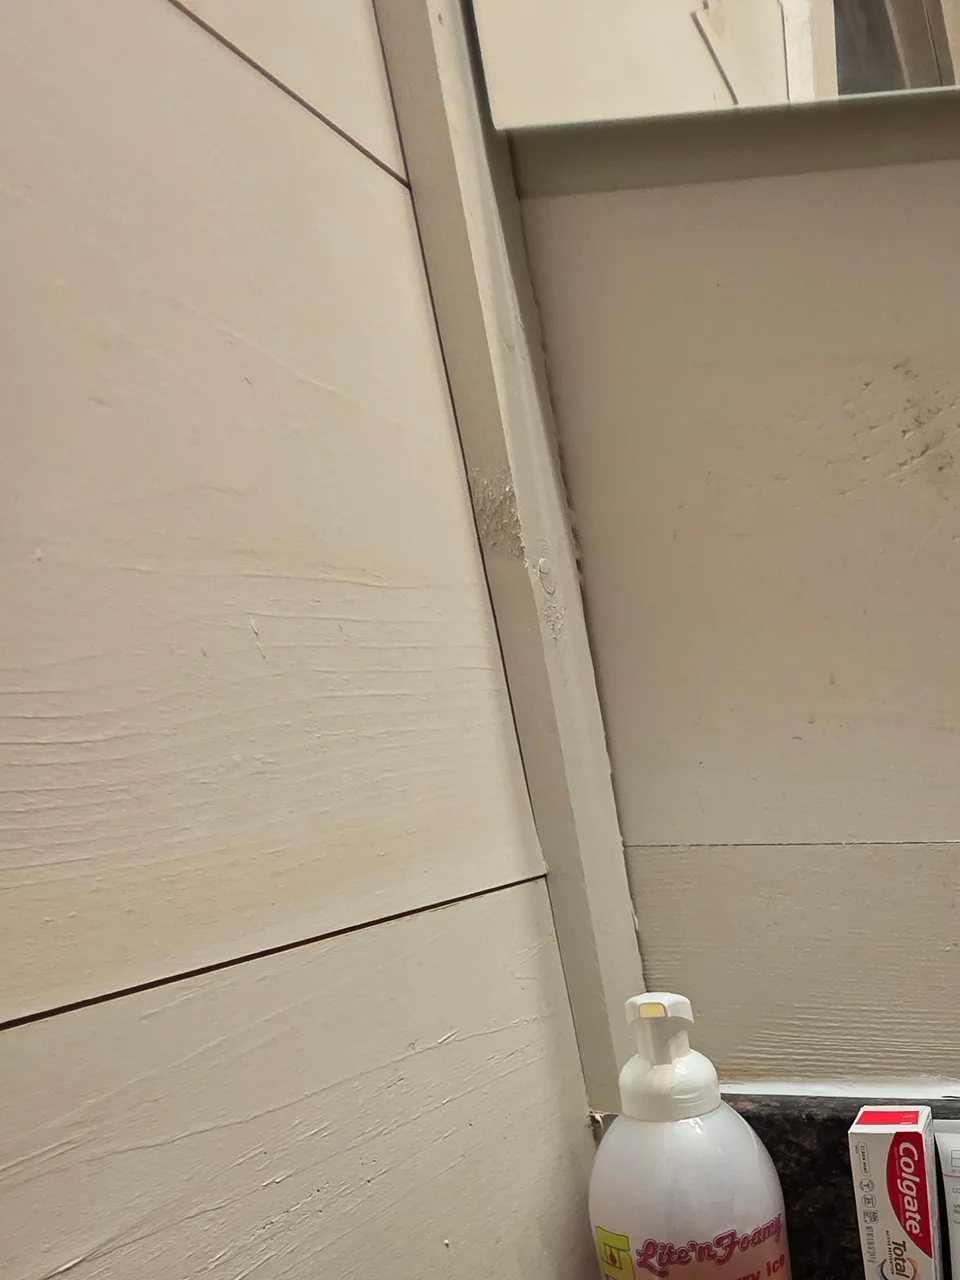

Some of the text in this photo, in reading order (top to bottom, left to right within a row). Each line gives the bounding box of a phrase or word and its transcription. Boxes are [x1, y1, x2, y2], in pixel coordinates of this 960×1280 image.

[897, 1142, 923, 1234] Colgate
[712, 1212, 782, 1266] Foamy
[892, 1240, 910, 1279] Total
[766, 1254, 786, 1279] Ice
